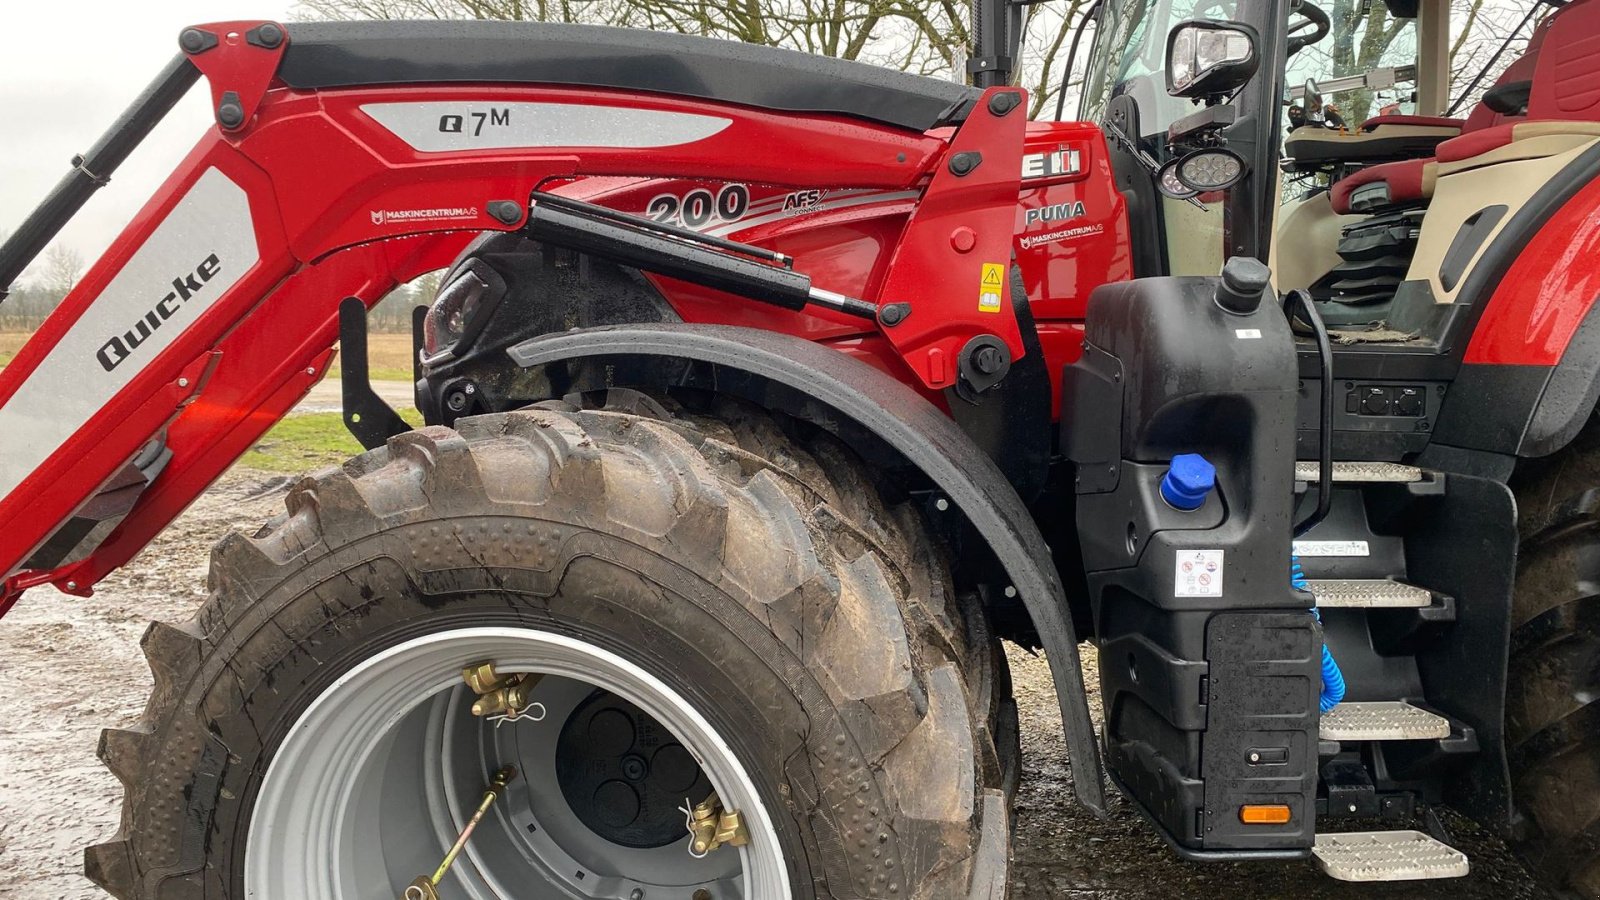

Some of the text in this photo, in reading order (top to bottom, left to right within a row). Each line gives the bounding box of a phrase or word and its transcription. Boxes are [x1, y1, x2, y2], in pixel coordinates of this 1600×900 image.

[645, 183, 751, 230] 200
[782, 189, 821, 212] AFS
[1025, 201, 1087, 226] PUMA
[96, 253, 221, 372] Quicke
